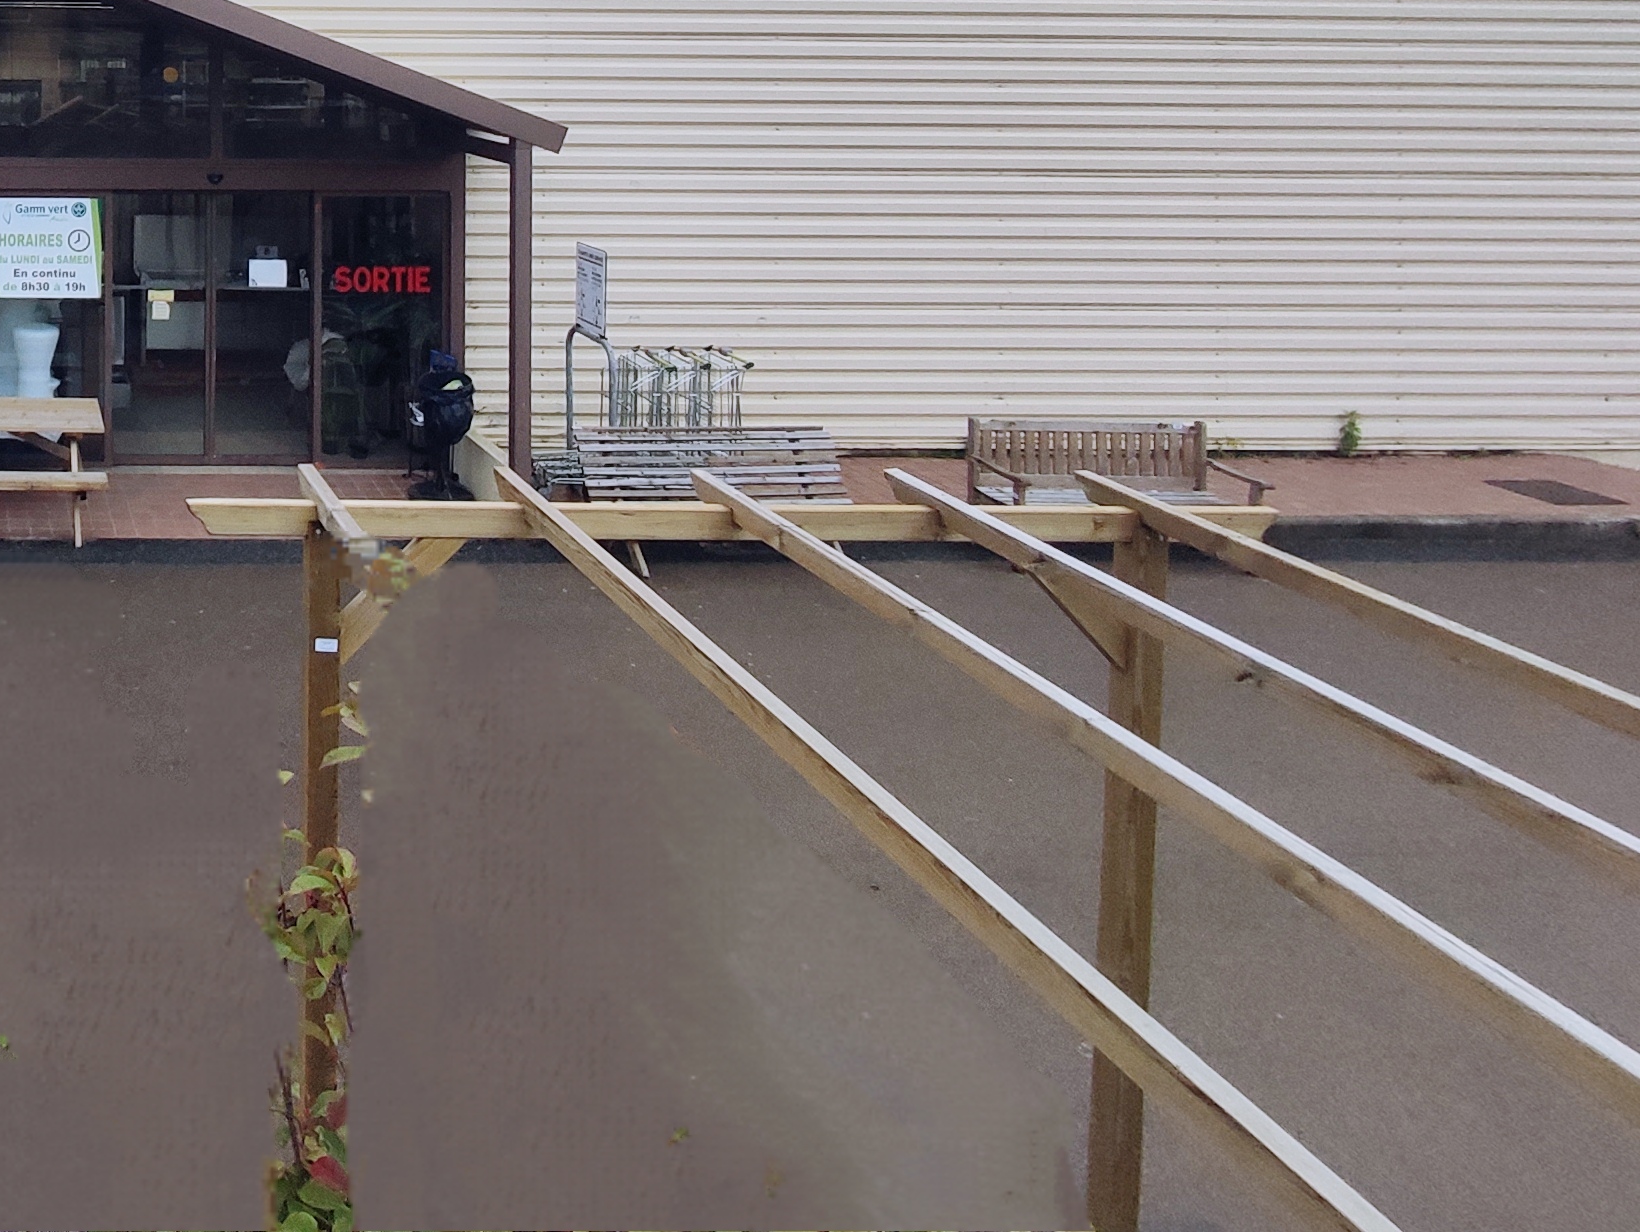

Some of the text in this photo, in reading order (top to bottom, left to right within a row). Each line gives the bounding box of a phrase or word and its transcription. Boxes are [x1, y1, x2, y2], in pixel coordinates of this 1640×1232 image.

[15, 203, 68, 214] Gamm vert
[11, 255, 40, 264] LUNDI
[56, 255, 93, 264] SAMEDI
[13, 268, 76, 278] En continu
[335, 266, 431, 293] SORTIE
[3, 282, 17, 291] de
[21, 282, 50, 291] 8h30
[64, 282, 86, 291] 19h
